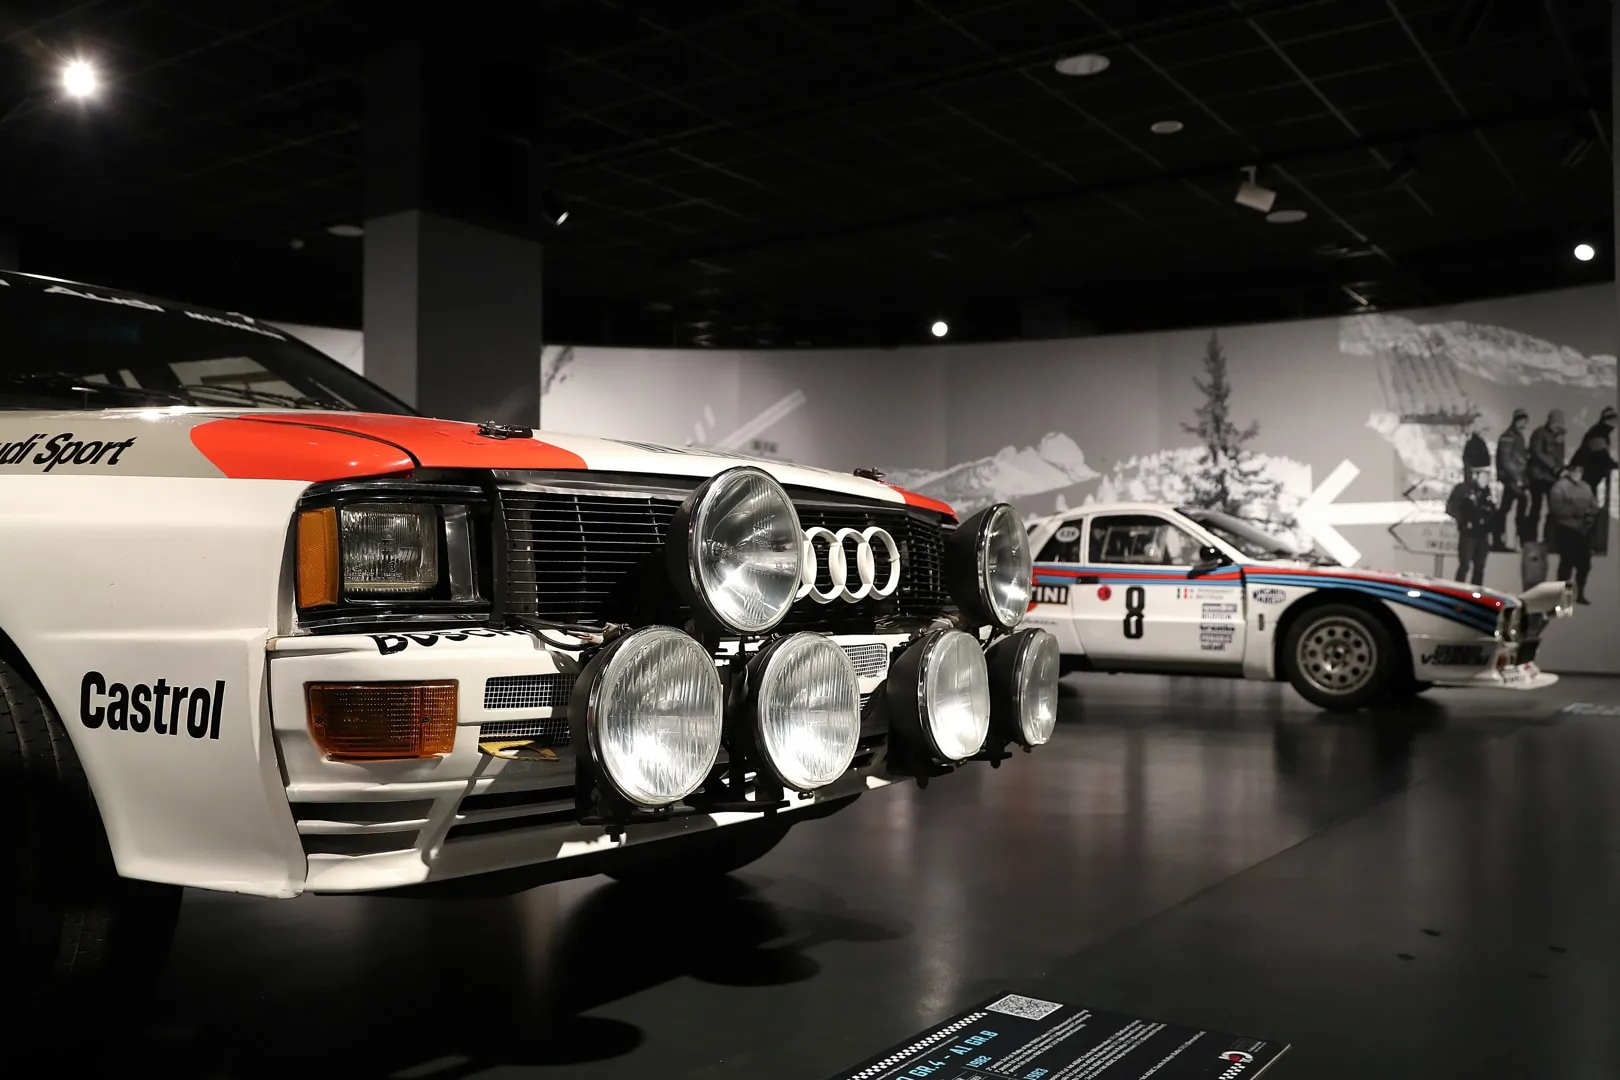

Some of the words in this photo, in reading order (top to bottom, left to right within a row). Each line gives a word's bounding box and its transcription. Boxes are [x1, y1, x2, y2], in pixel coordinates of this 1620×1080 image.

[33, 432, 138, 472] Sport
[1123, 586, 1145, 639] 8
[80, 671, 225, 739] Castrol
[908, 1060, 946, 1077] GR.4
[949, 1045, 973, 1056] A1
[964, 1030, 999, 1046] GR.B
[966, 1055, 992, 1068] 1982
